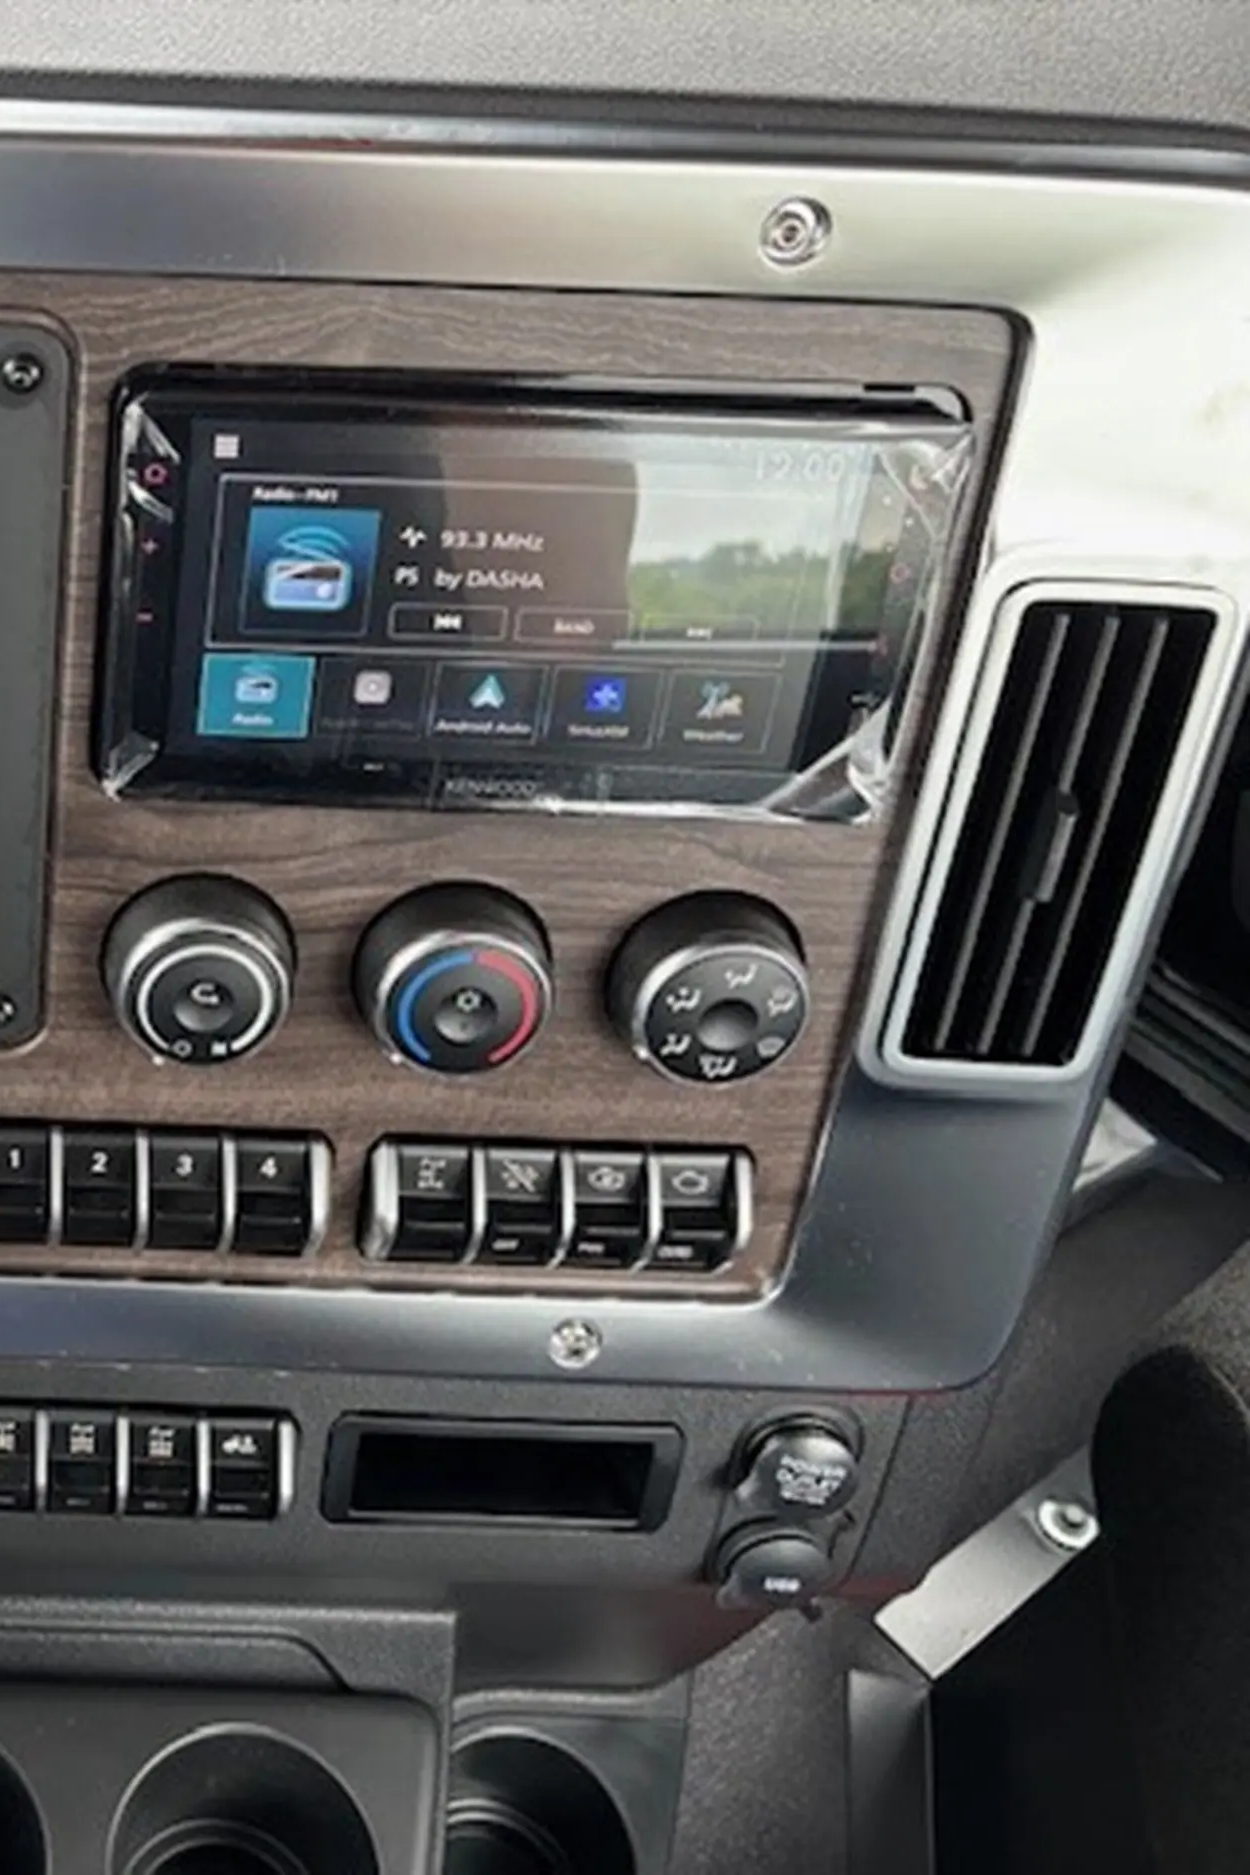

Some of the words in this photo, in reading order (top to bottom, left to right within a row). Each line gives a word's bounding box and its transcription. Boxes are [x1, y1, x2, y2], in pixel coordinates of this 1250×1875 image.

[440, 529, 487, 549] 93.3
[435, 567, 463, 591] by
[466, 569, 544, 591] DASHA
[9, 1148, 21, 1169] 1
[90, 1151, 109, 1174] 2
[175, 1153, 194, 1177] 3
[259, 1156, 278, 1178] 4
